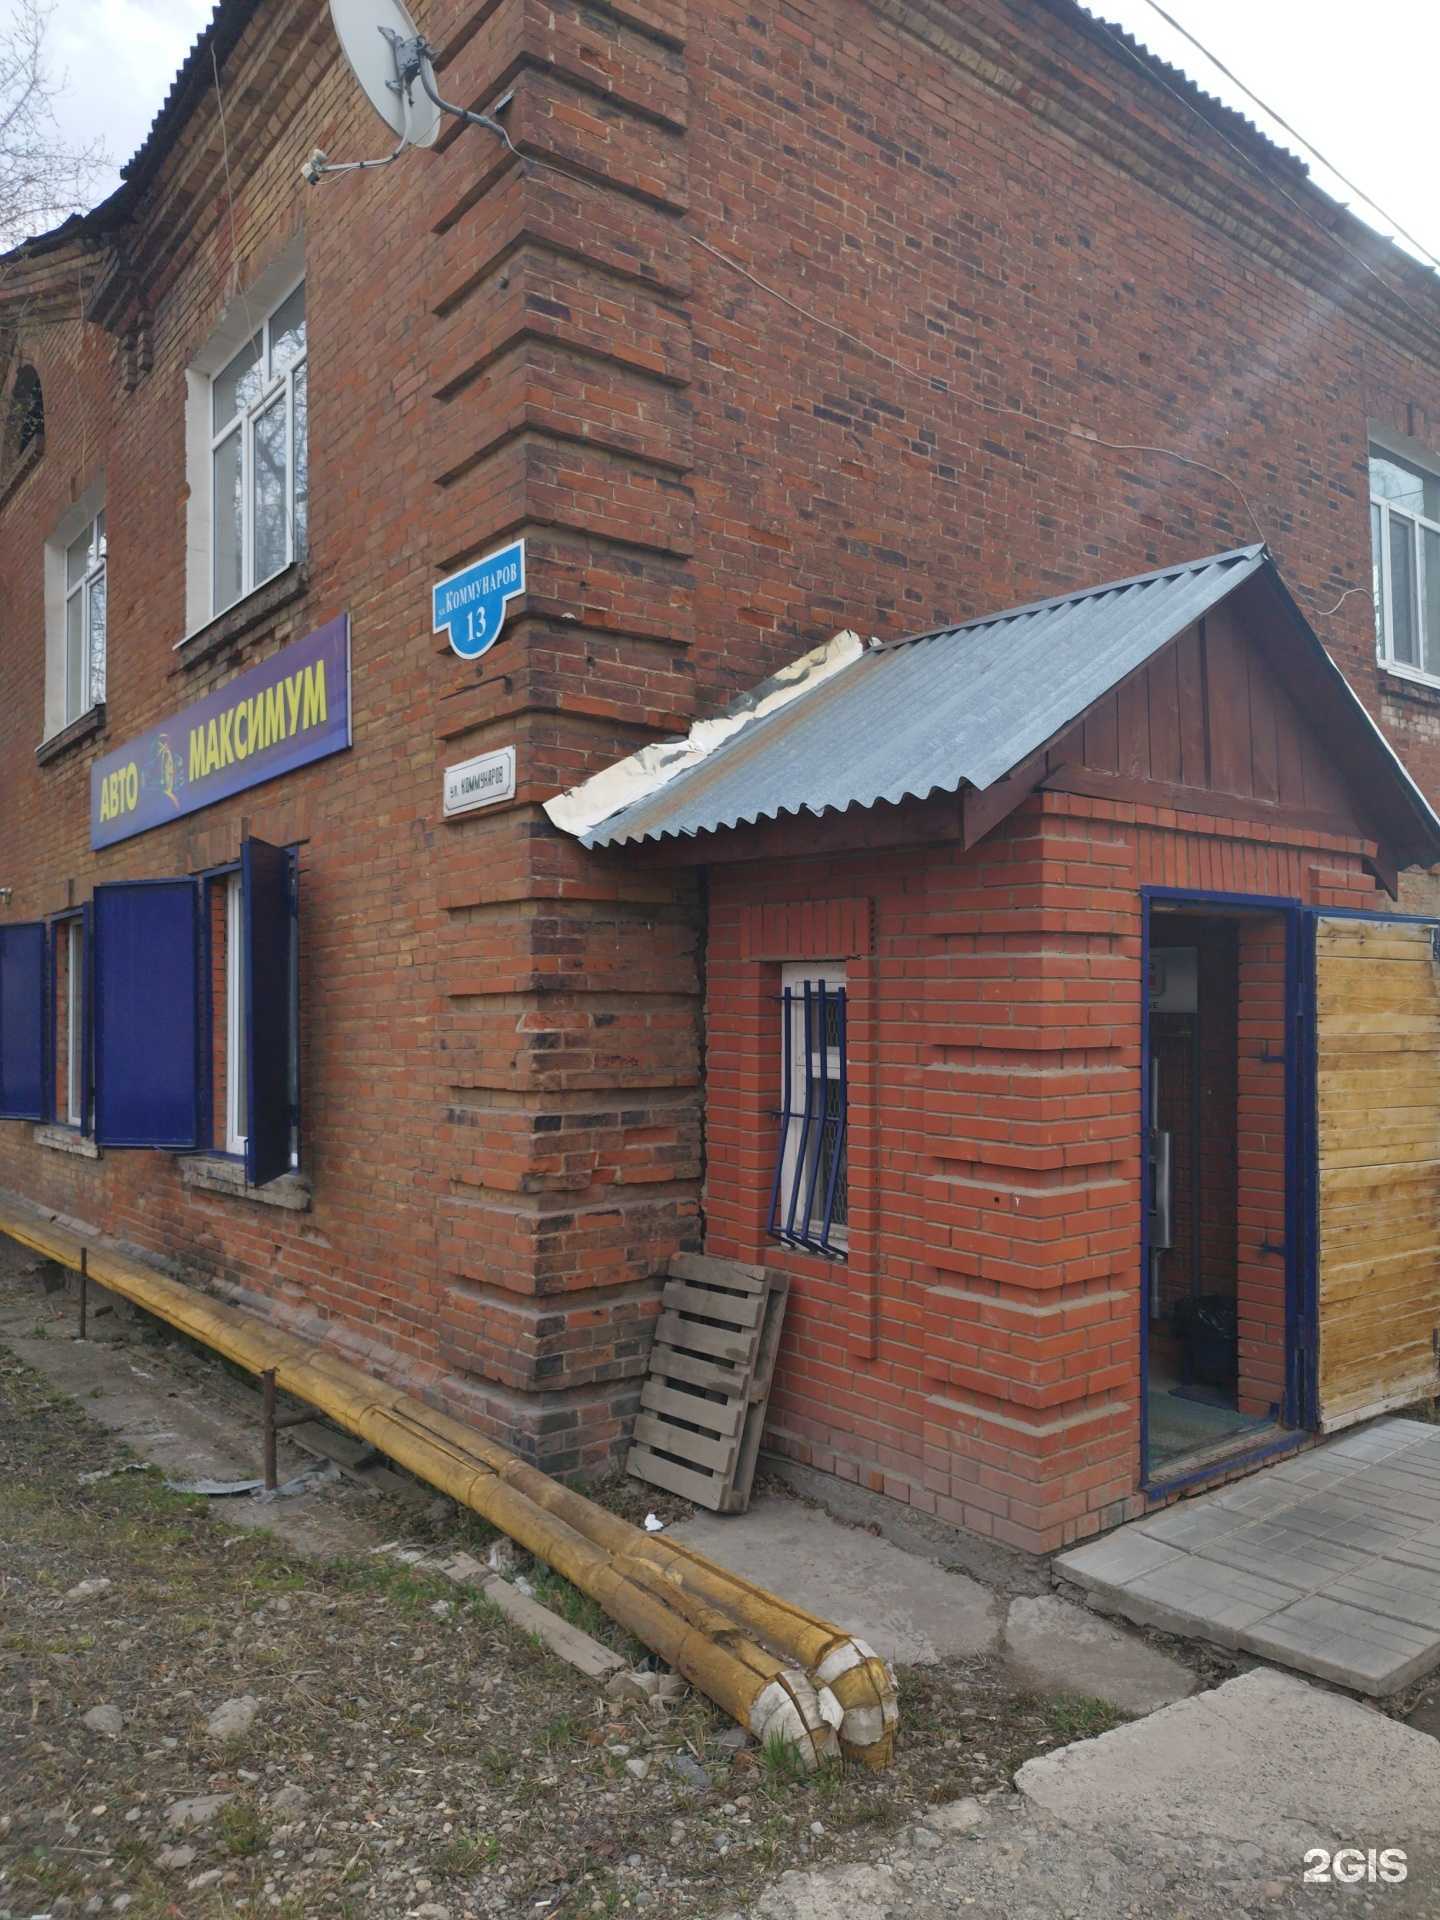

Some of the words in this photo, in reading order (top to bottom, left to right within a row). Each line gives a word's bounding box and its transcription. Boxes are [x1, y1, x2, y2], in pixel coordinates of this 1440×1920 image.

[445, 562, 518, 613] КОММУНАРОВ
[467, 606, 487, 641] 13
[99, 761, 139, 824] АВТО
[188, 659, 328, 784] МАКСИМУМ
[461, 765, 504, 796] КОММУНАРОВ
